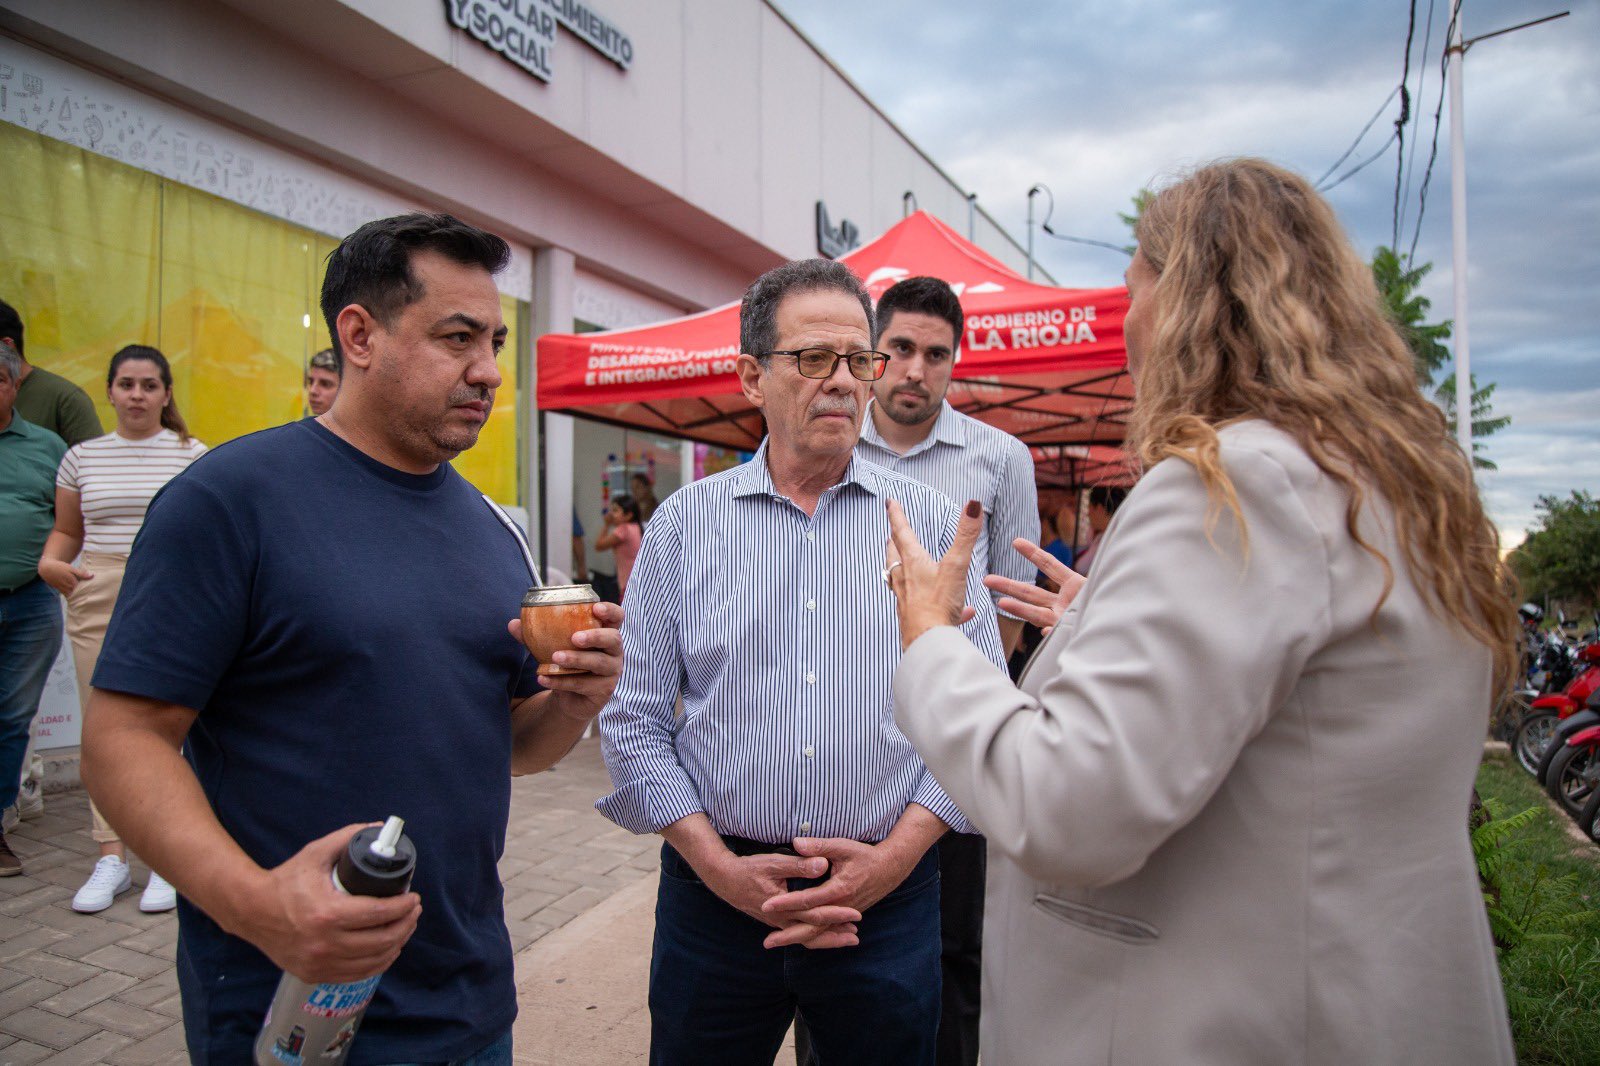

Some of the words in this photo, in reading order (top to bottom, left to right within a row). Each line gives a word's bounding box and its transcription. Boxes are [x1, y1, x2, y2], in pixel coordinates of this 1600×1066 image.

[473, 3, 552, 76] SOCIAL
[966, 308, 1066, 330] GOBIERNO
[1070, 305, 1097, 323] DE
[967, 328, 1007, 351] LA
[1011, 321, 1097, 349] RIOJA
[585, 372, 597, 386] E
[598, 360, 709, 385] INTEGRACIÓN
